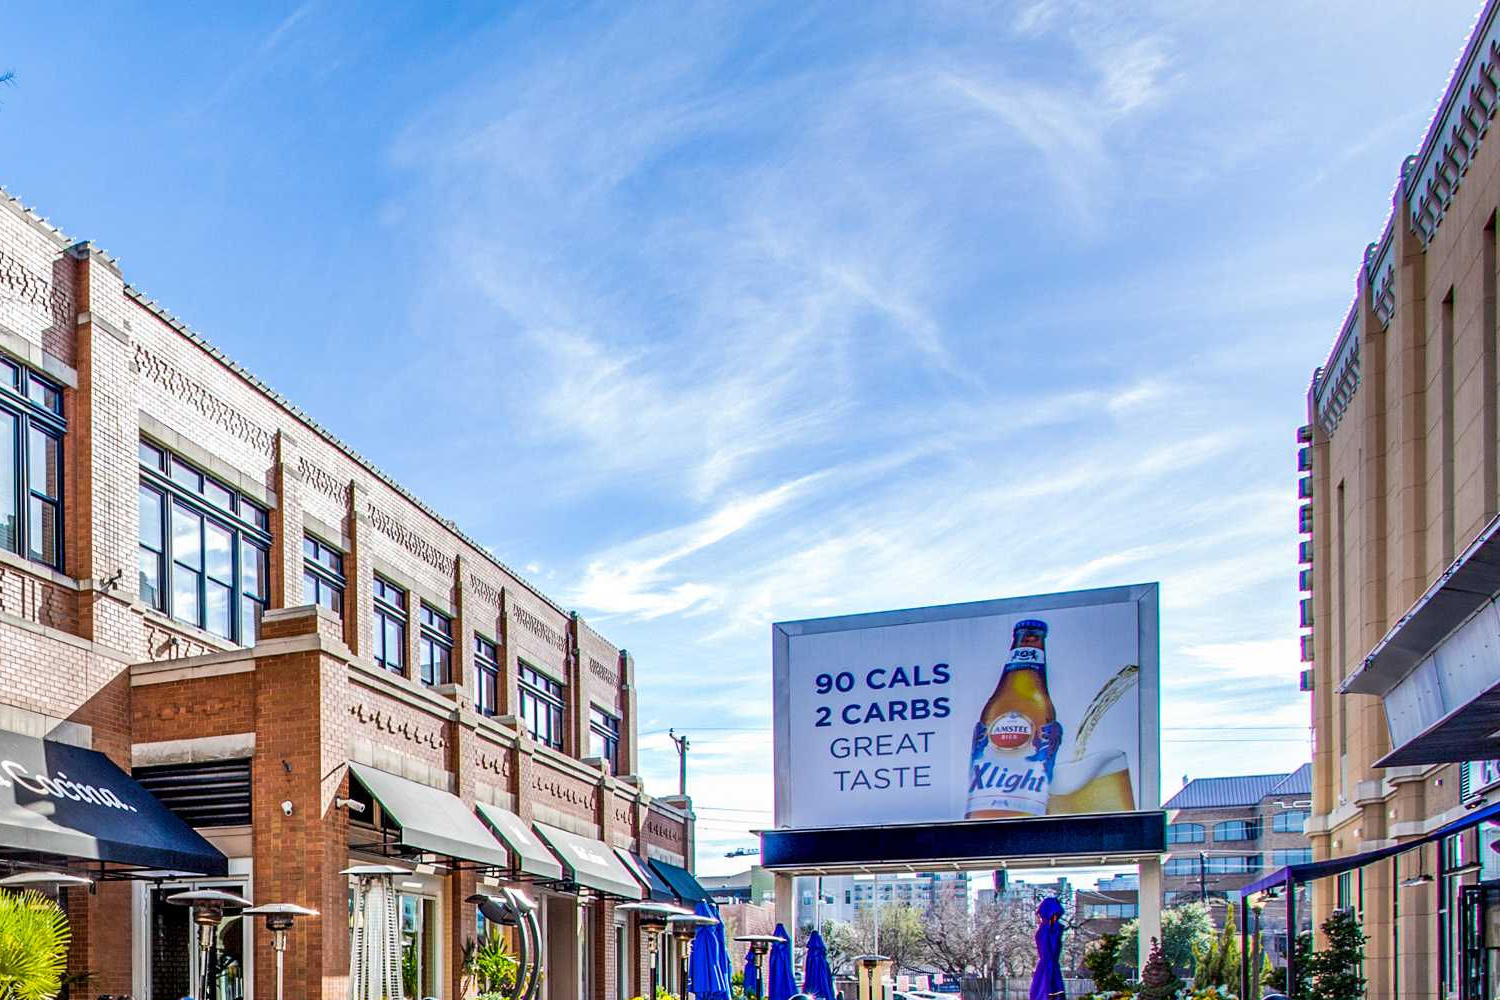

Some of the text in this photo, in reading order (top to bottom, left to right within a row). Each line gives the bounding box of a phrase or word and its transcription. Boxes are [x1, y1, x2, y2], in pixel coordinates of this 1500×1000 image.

[815, 663, 951, 695] 90 CALS
[815, 696, 951, 728] 2 CARBS
[830, 731, 936, 759] GREAT
[833, 765, 932, 792] TASTE
[968, 761, 1047, 794] Xlight
